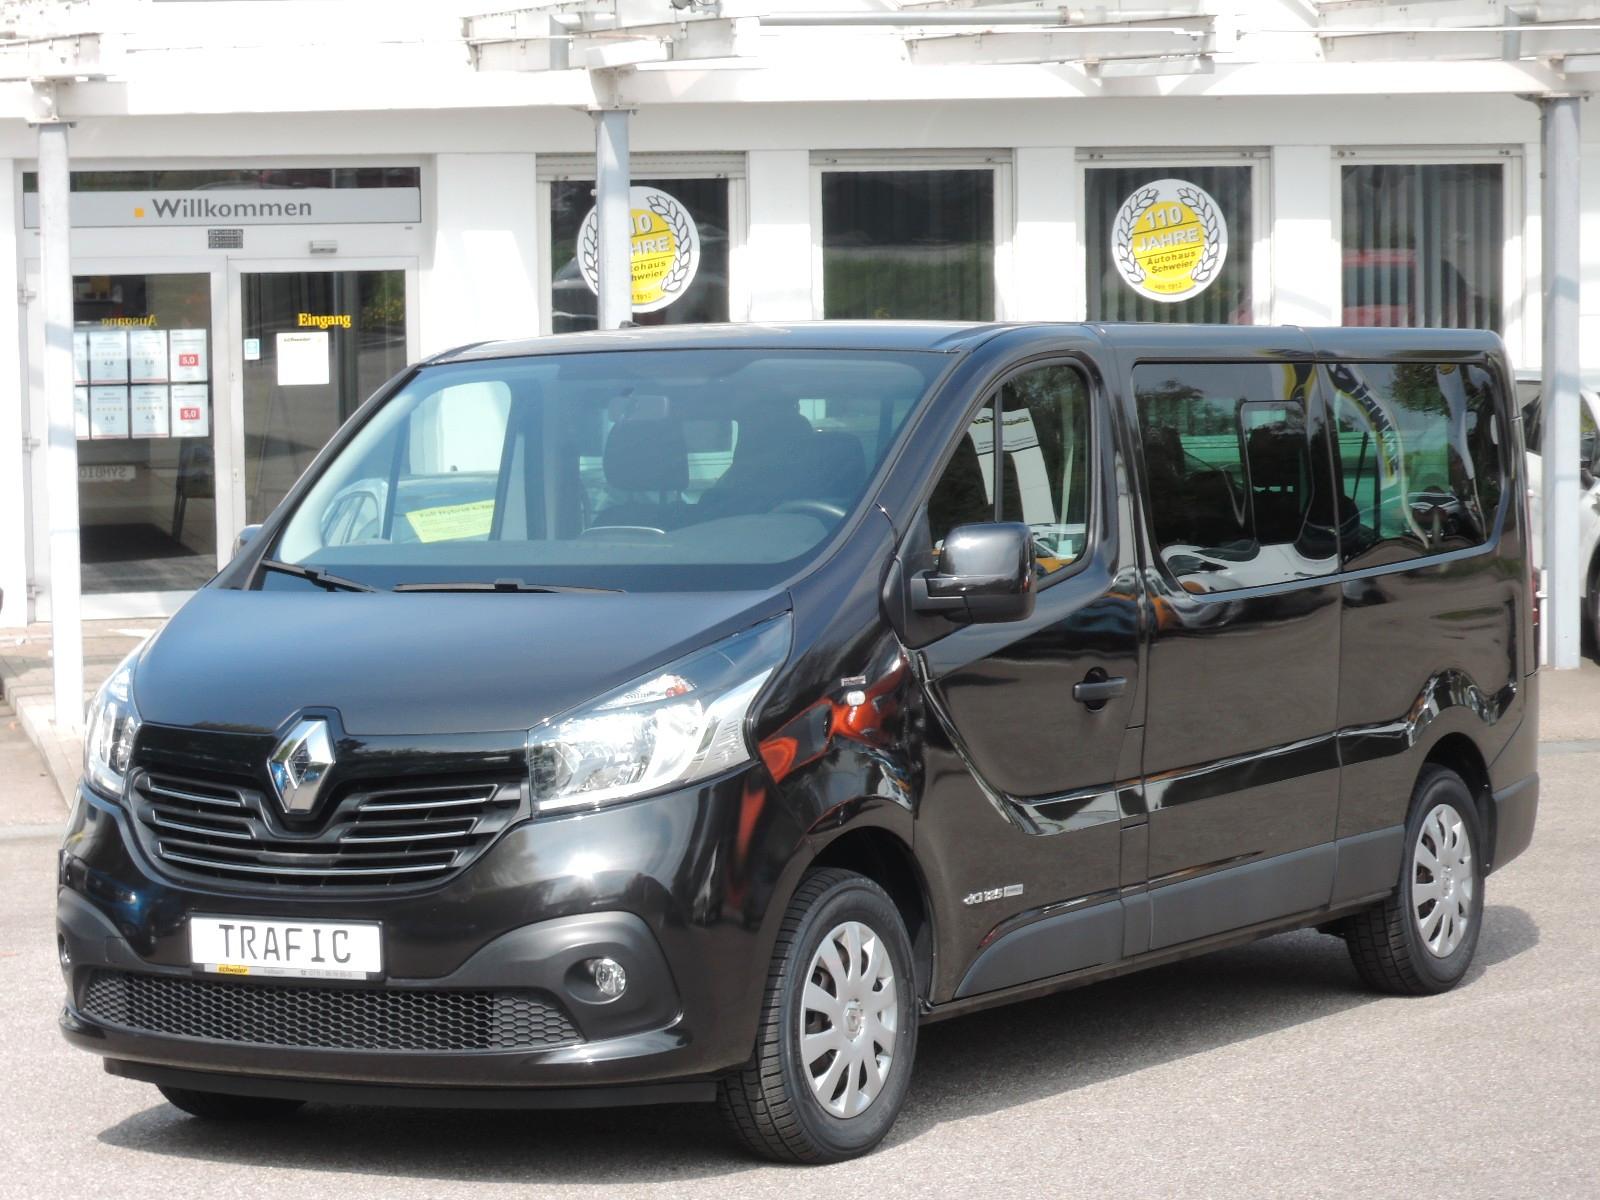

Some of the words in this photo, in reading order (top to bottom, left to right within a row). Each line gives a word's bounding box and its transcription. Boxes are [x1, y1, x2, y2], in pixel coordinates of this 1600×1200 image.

[152, 197, 312, 219] Willkommen
[1145, 206, 1184, 229] 110
[631, 236, 671, 256] HRE
[1136, 228, 1201, 252] JAHRE
[1146, 251, 1197, 266] Autohaus
[1151, 260, 1194, 274] Schweier
[631, 270, 664, 281] hweier
[298, 313, 352, 329] Eingang
[218, 923, 351, 964] TRAFIC
